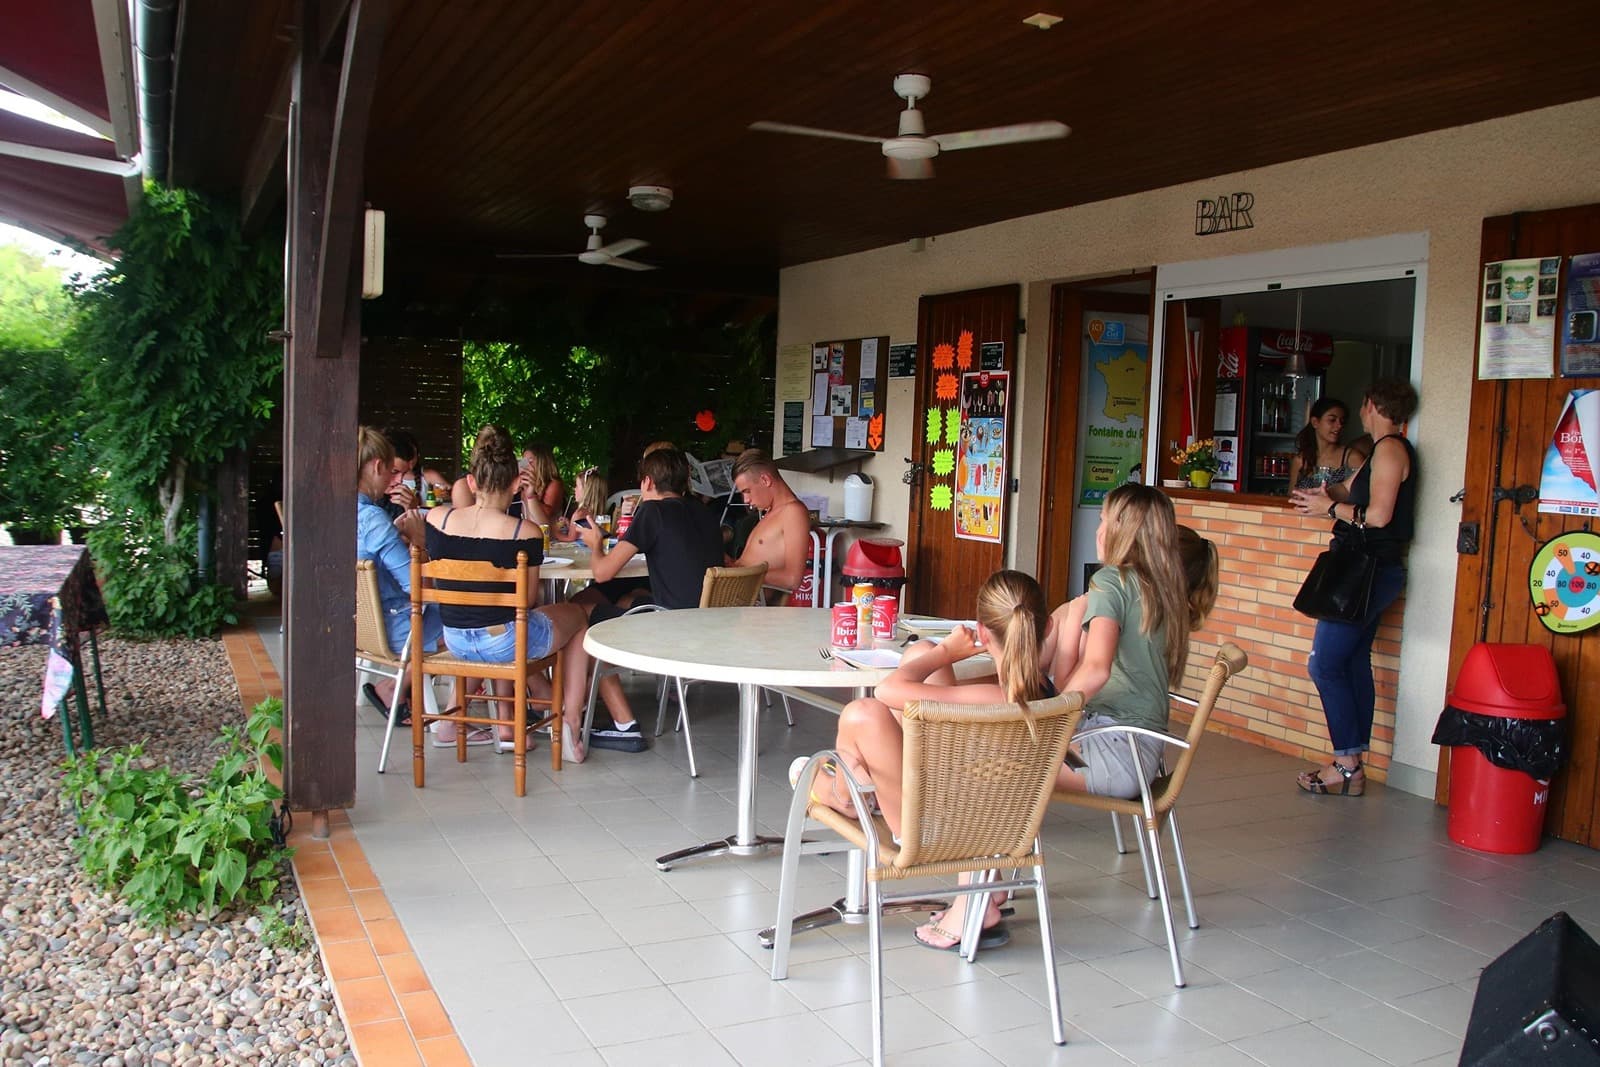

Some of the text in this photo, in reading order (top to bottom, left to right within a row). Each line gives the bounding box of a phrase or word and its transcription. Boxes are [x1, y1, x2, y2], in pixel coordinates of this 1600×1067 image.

[1195, 192, 1254, 236] BAR
[1088, 424, 1124, 438] Fontaine
[1126, 426, 1137, 438] du
[1558, 549, 1568, 557] 50
[1580, 552, 1590, 560] 40
[1557, 580, 1567, 588] 80
[1571, 580, 1585, 588] 100
[1586, 582, 1597, 590] 80
[1550, 600, 1559, 608] 50
[1580, 607, 1590, 615] 40
